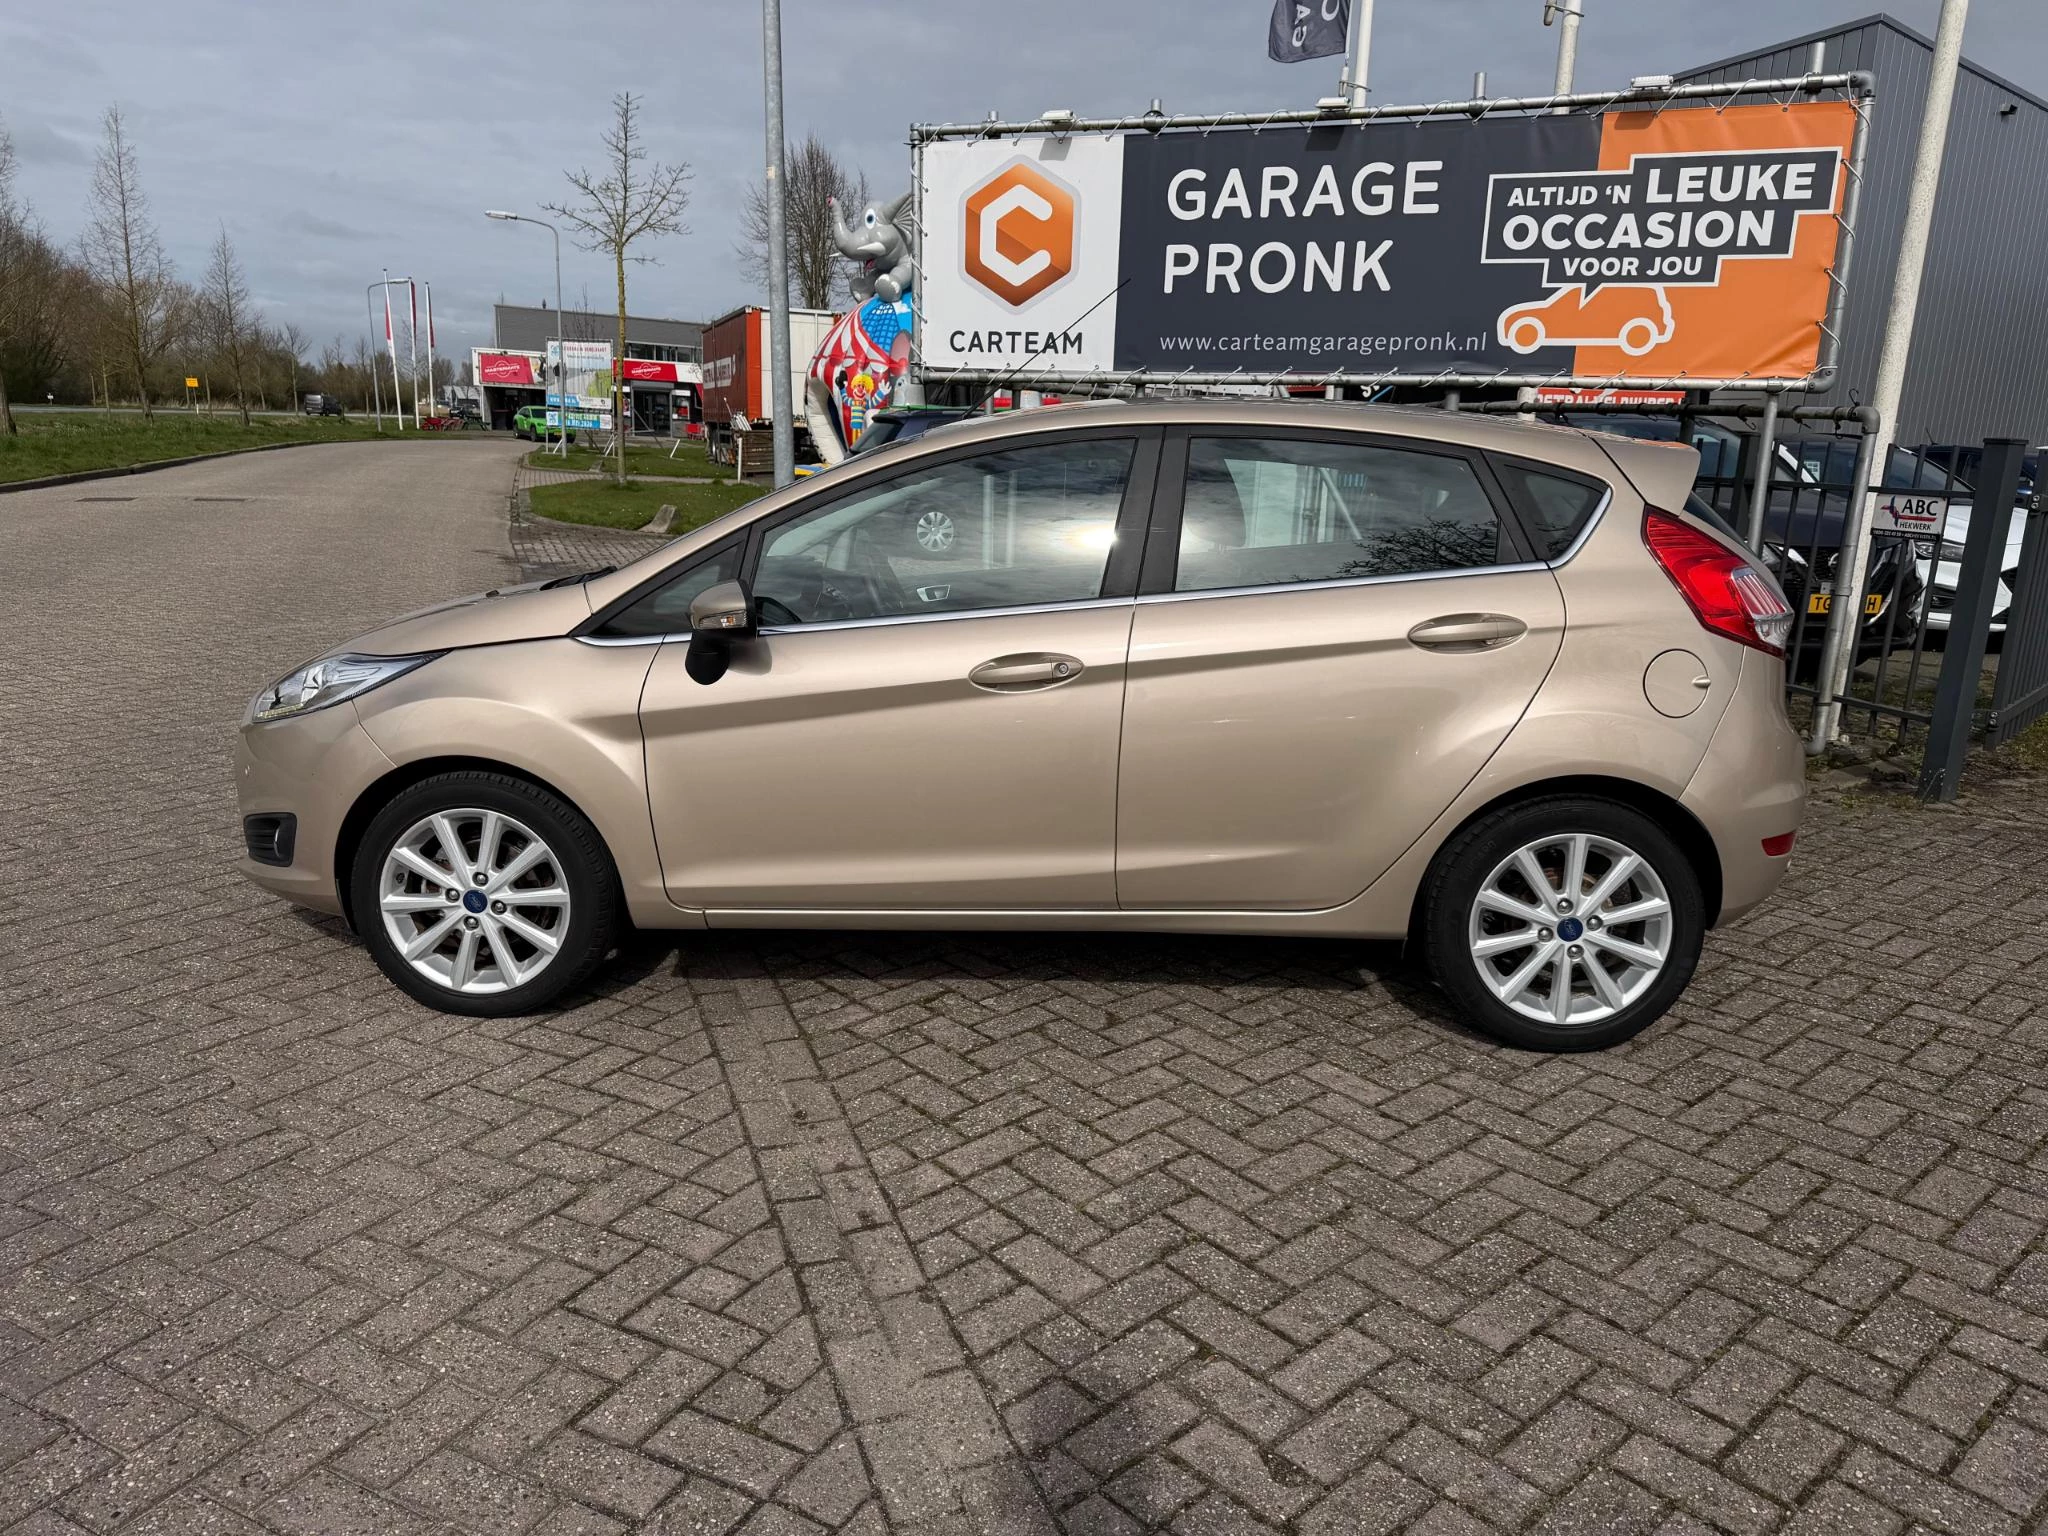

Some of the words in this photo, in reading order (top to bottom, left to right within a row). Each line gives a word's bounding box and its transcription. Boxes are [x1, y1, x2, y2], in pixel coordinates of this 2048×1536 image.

[1167, 160, 1443, 221] GARAGE
[1507, 185, 1598, 207] ALTIJD
[1645, 162, 1817, 204] LEUKE
[1502, 209, 1775, 251] OCCASION
[1163, 239, 1394, 294] PRONK
[1562, 256, 1640, 277] VOOR
[1645, 256, 1703, 276] JOU
[949, 330, 1083, 355] CARTEAM
[1159, 331, 1487, 356] www.carteamgaragepronk.nl
[1901, 498, 1938, 516] ABC
[1899, 522, 1932, 531] HEKWERK
